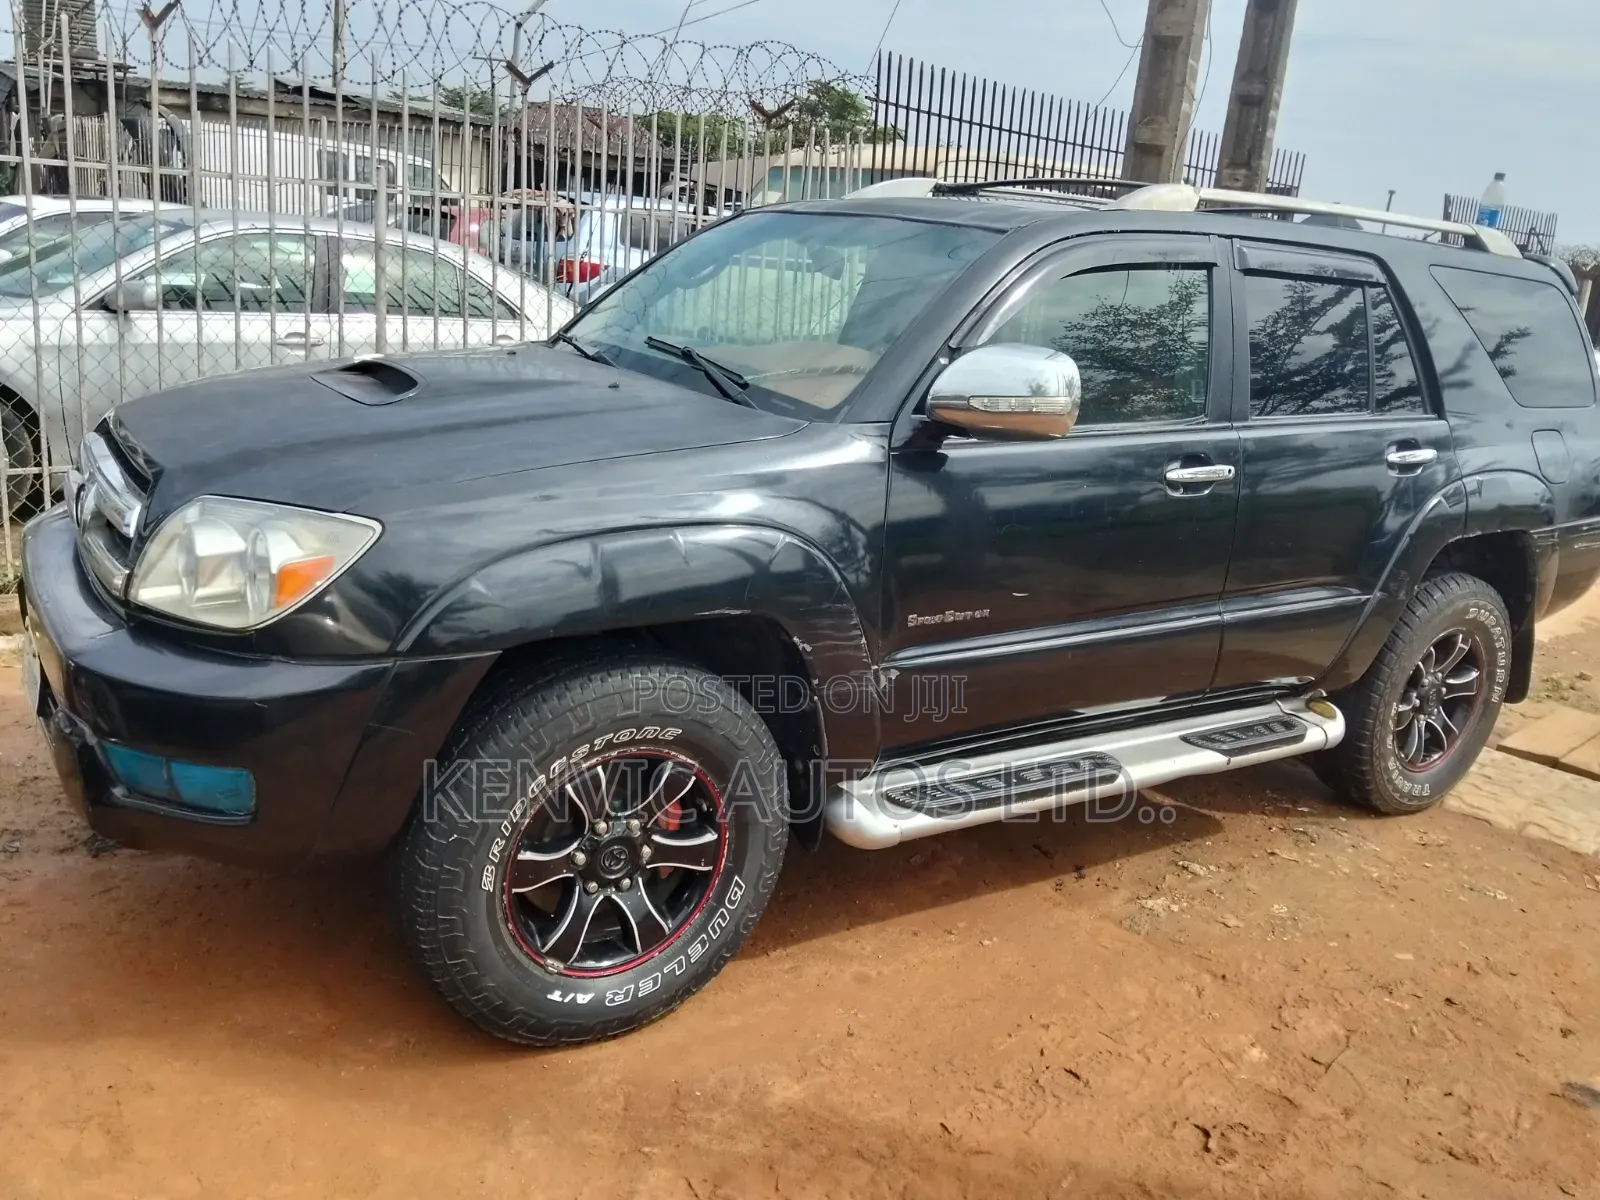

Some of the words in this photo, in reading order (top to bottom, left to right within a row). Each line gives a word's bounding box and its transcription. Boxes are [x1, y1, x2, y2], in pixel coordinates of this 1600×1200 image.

[481, 725, 683, 893] BRIDGESTONE
[546, 988, 596, 1005] A/T
[605, 875, 746, 1007] DUELER
